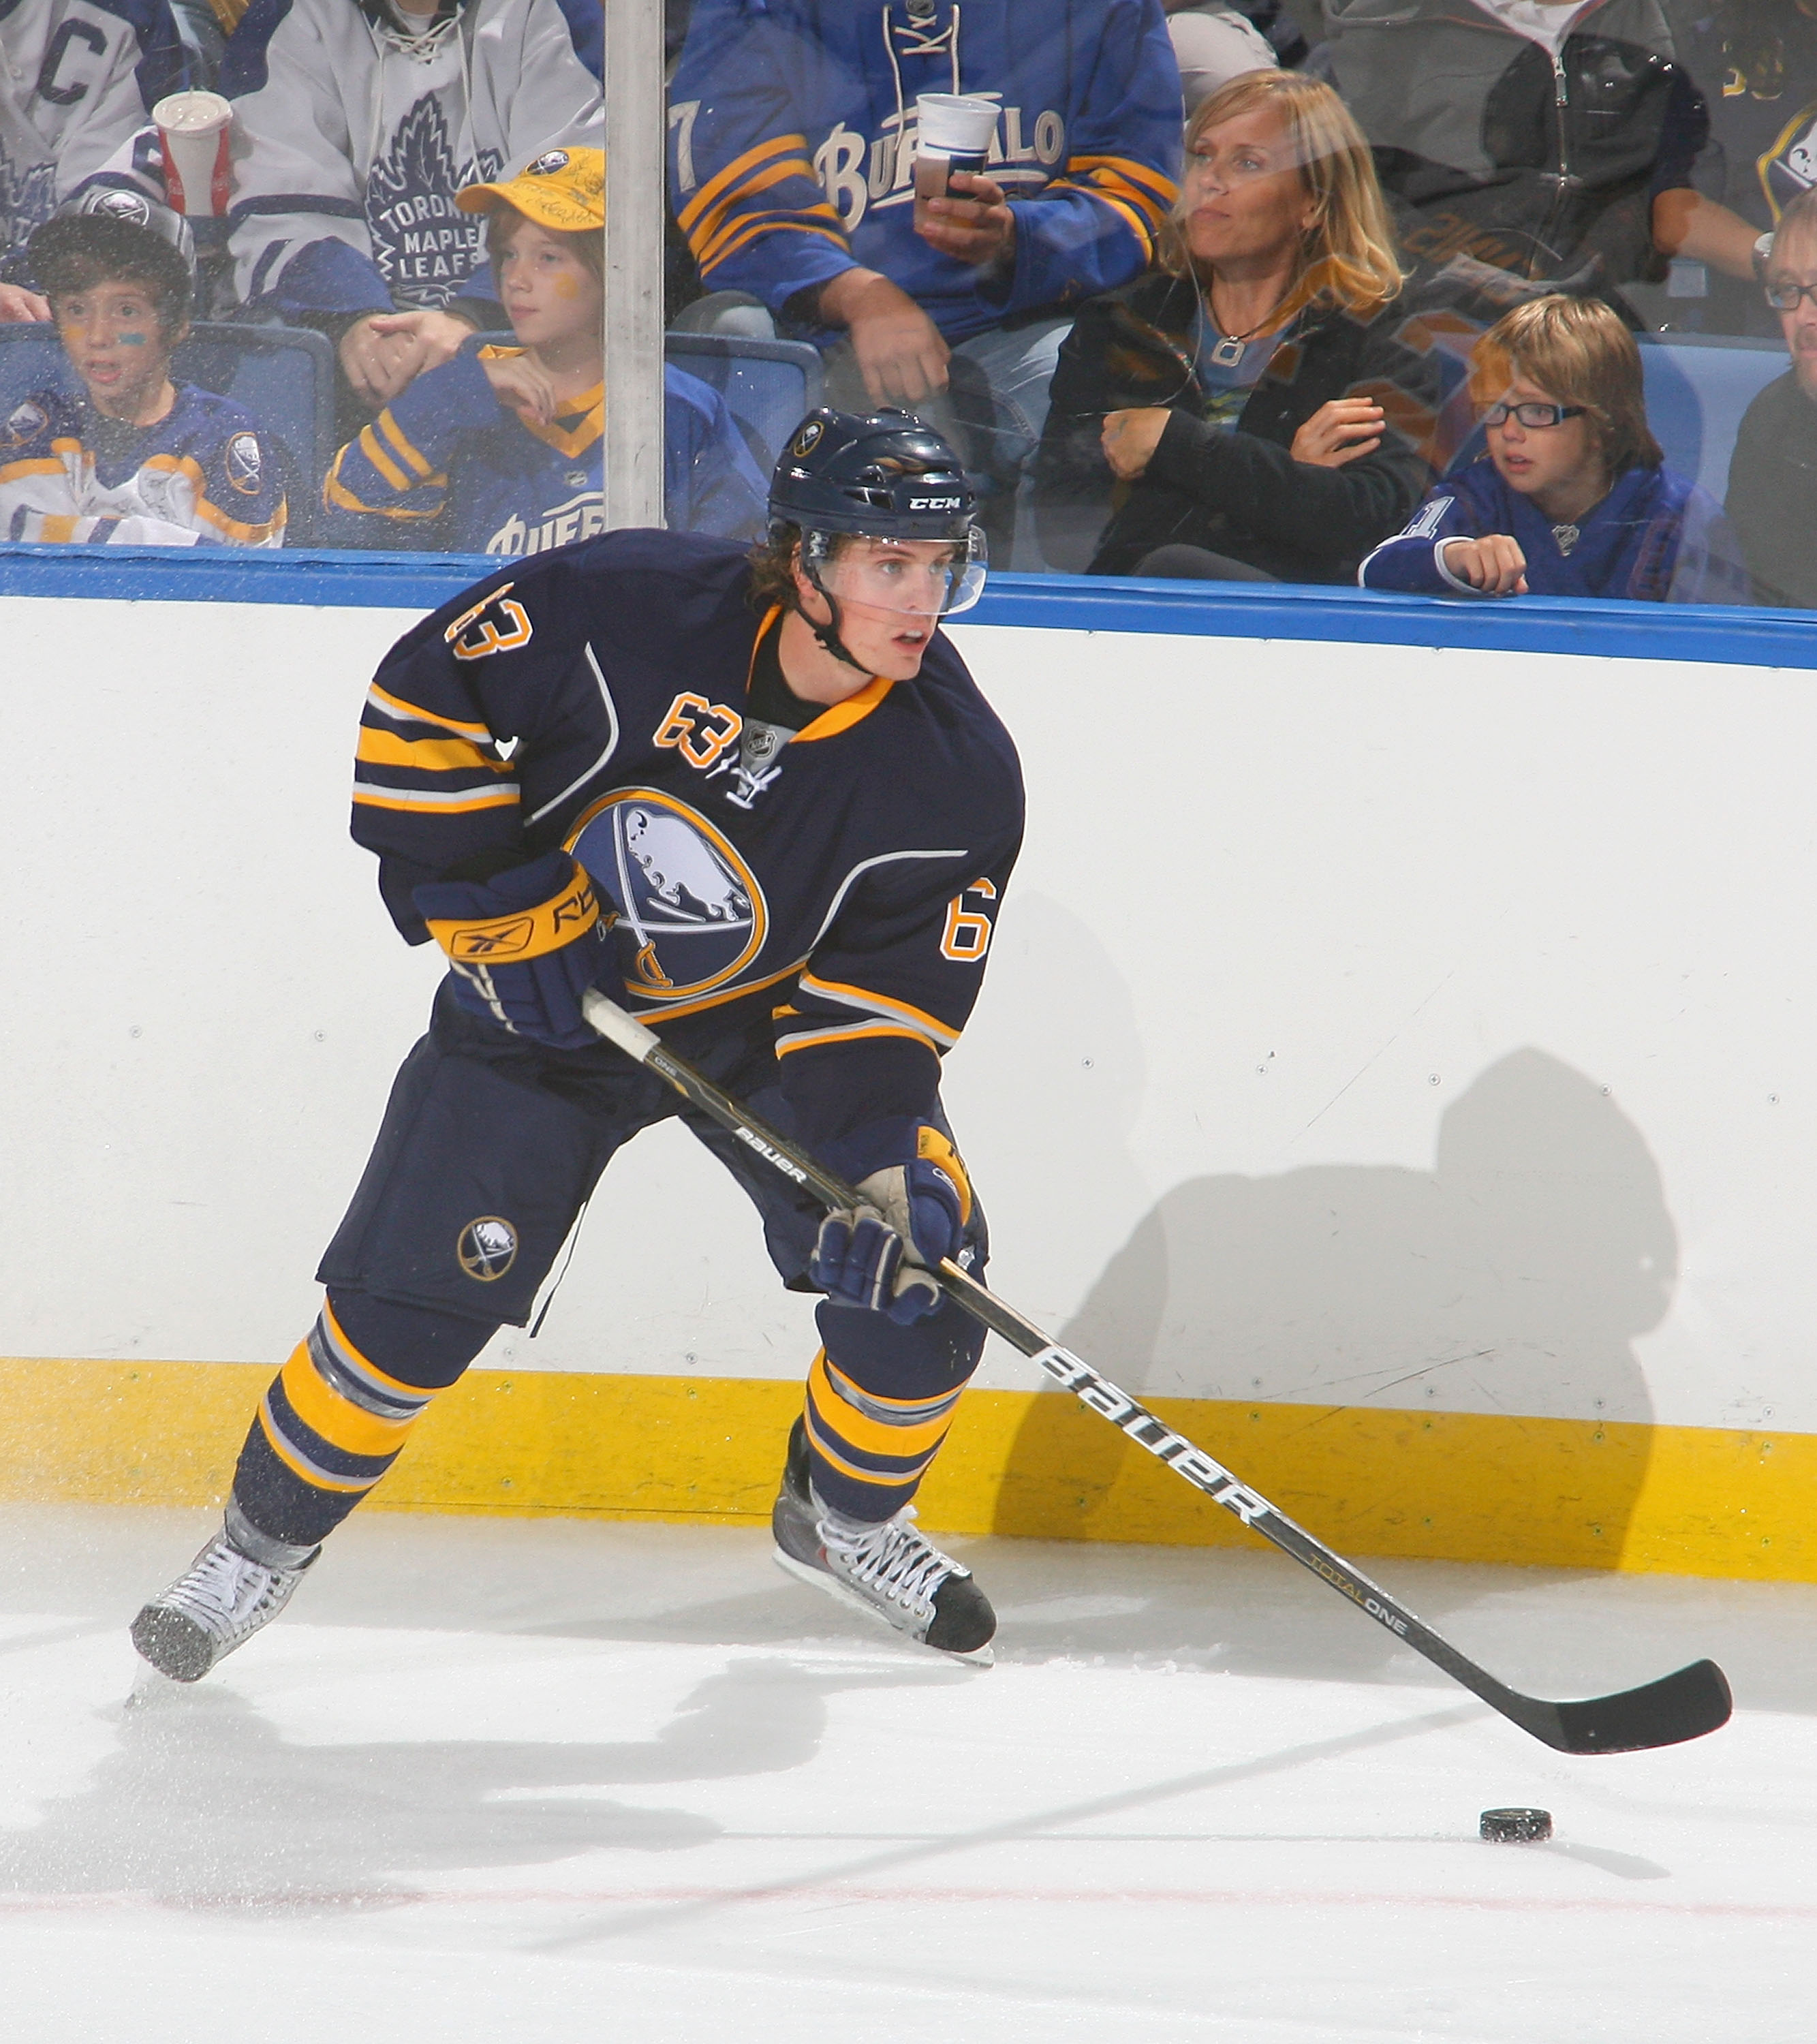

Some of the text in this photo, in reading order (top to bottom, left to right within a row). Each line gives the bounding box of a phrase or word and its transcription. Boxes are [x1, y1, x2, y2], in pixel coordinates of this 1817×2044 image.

[37, 18, 108, 106] C
[668, 100, 701, 191] 7
[404, 228, 478, 253] MAPLE
[909, 497, 961, 510] CCM
[653, 691, 743, 769] 63
